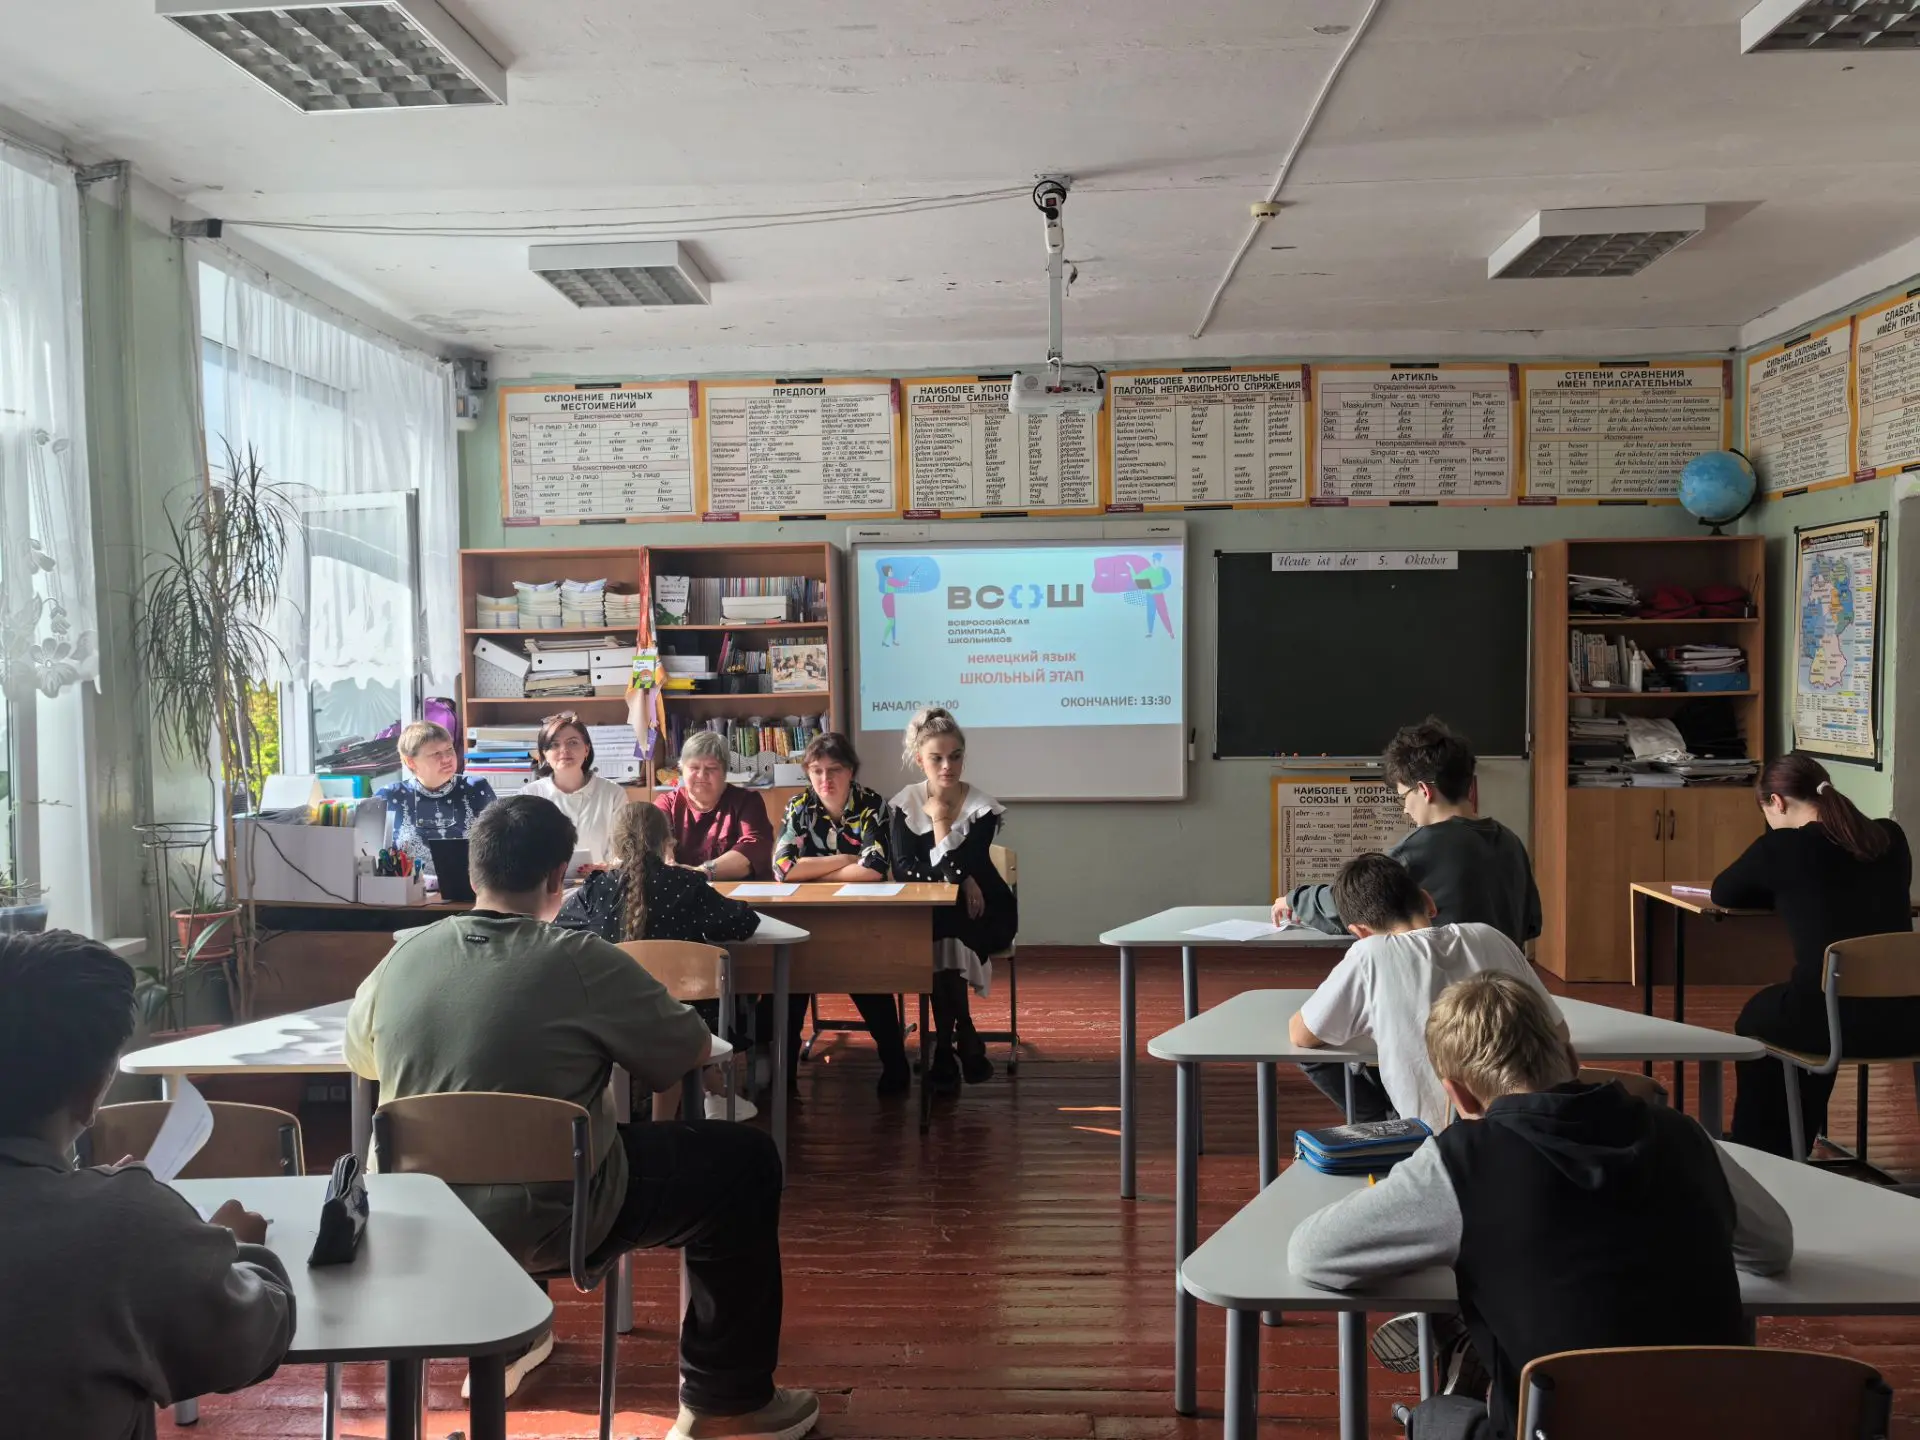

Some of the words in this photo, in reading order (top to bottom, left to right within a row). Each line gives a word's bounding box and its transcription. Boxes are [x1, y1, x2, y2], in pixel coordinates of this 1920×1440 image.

[1885, 303, 1914, 321] СЛАБОЕ
[1766, 351, 1792, 368] СИЛЬНОЕ
[1134, 376, 1183, 386] НАИБОЛЕЕ
[1187, 373, 1280, 384] УПОТРЕБИТЕЛЬНЫЕ
[1391, 373, 1439, 381] АРТИКЛЬ
[1565, 371, 1614, 379] СТЕПЕНИ
[1620, 370, 1685, 379] СРАВНЕНИЯ
[1114, 386, 1156, 394] ГЛАГОЛЫ
[1160, 383, 1240, 394] НЕПРАВИЛЬНОГО
[1244, 381, 1301, 391] СПРЯЖЕНИЯ
[1593, 379, 1693, 388] ПРИЛАГАТЕЛЬНЫХ
[773, 387, 826, 397] ПРЕДЛОГИ
[920, 385, 975, 394] НАИБОЛЕЕ
[544, 393, 604, 403] СКЛОНЕНИЕ
[610, 392, 653, 401] ЛИЧНЫХ
[913, 394, 960, 403] ГЛАГОЛЫ
[560, 401, 637, 411] МЕСТОИМЕНИЙ
[1370, 449, 1399, 457] Singular
[1277, 555, 1311, 566] Heute
[1317, 555, 1330, 566] ist
[1339, 554, 1359, 566] der
[1378, 555, 1388, 566] 5.
[1404, 554, 1448, 566] Oktober
[947, 618, 1030, 627] ВСЕРОССИЙСКАЯ
[947, 636, 1012, 644] ШКОЛЬНИКОВ
[967, 650, 1038, 665] немецкий
[1042, 652, 1077, 662] язык
[960, 668, 1045, 684] ШКОЛЬНЫЙ
[1049, 670, 1084, 683] ЭТАП
[1060, 695, 1138, 707] ОКОНЧАНИЕ:
[1140, 695, 1172, 706] 13:30
[1294, 786, 1348, 794] НАИБОЛЕЕ
[1299, 796, 1338, 804] СОЮЗЫ
[1344, 796, 1351, 804] И
